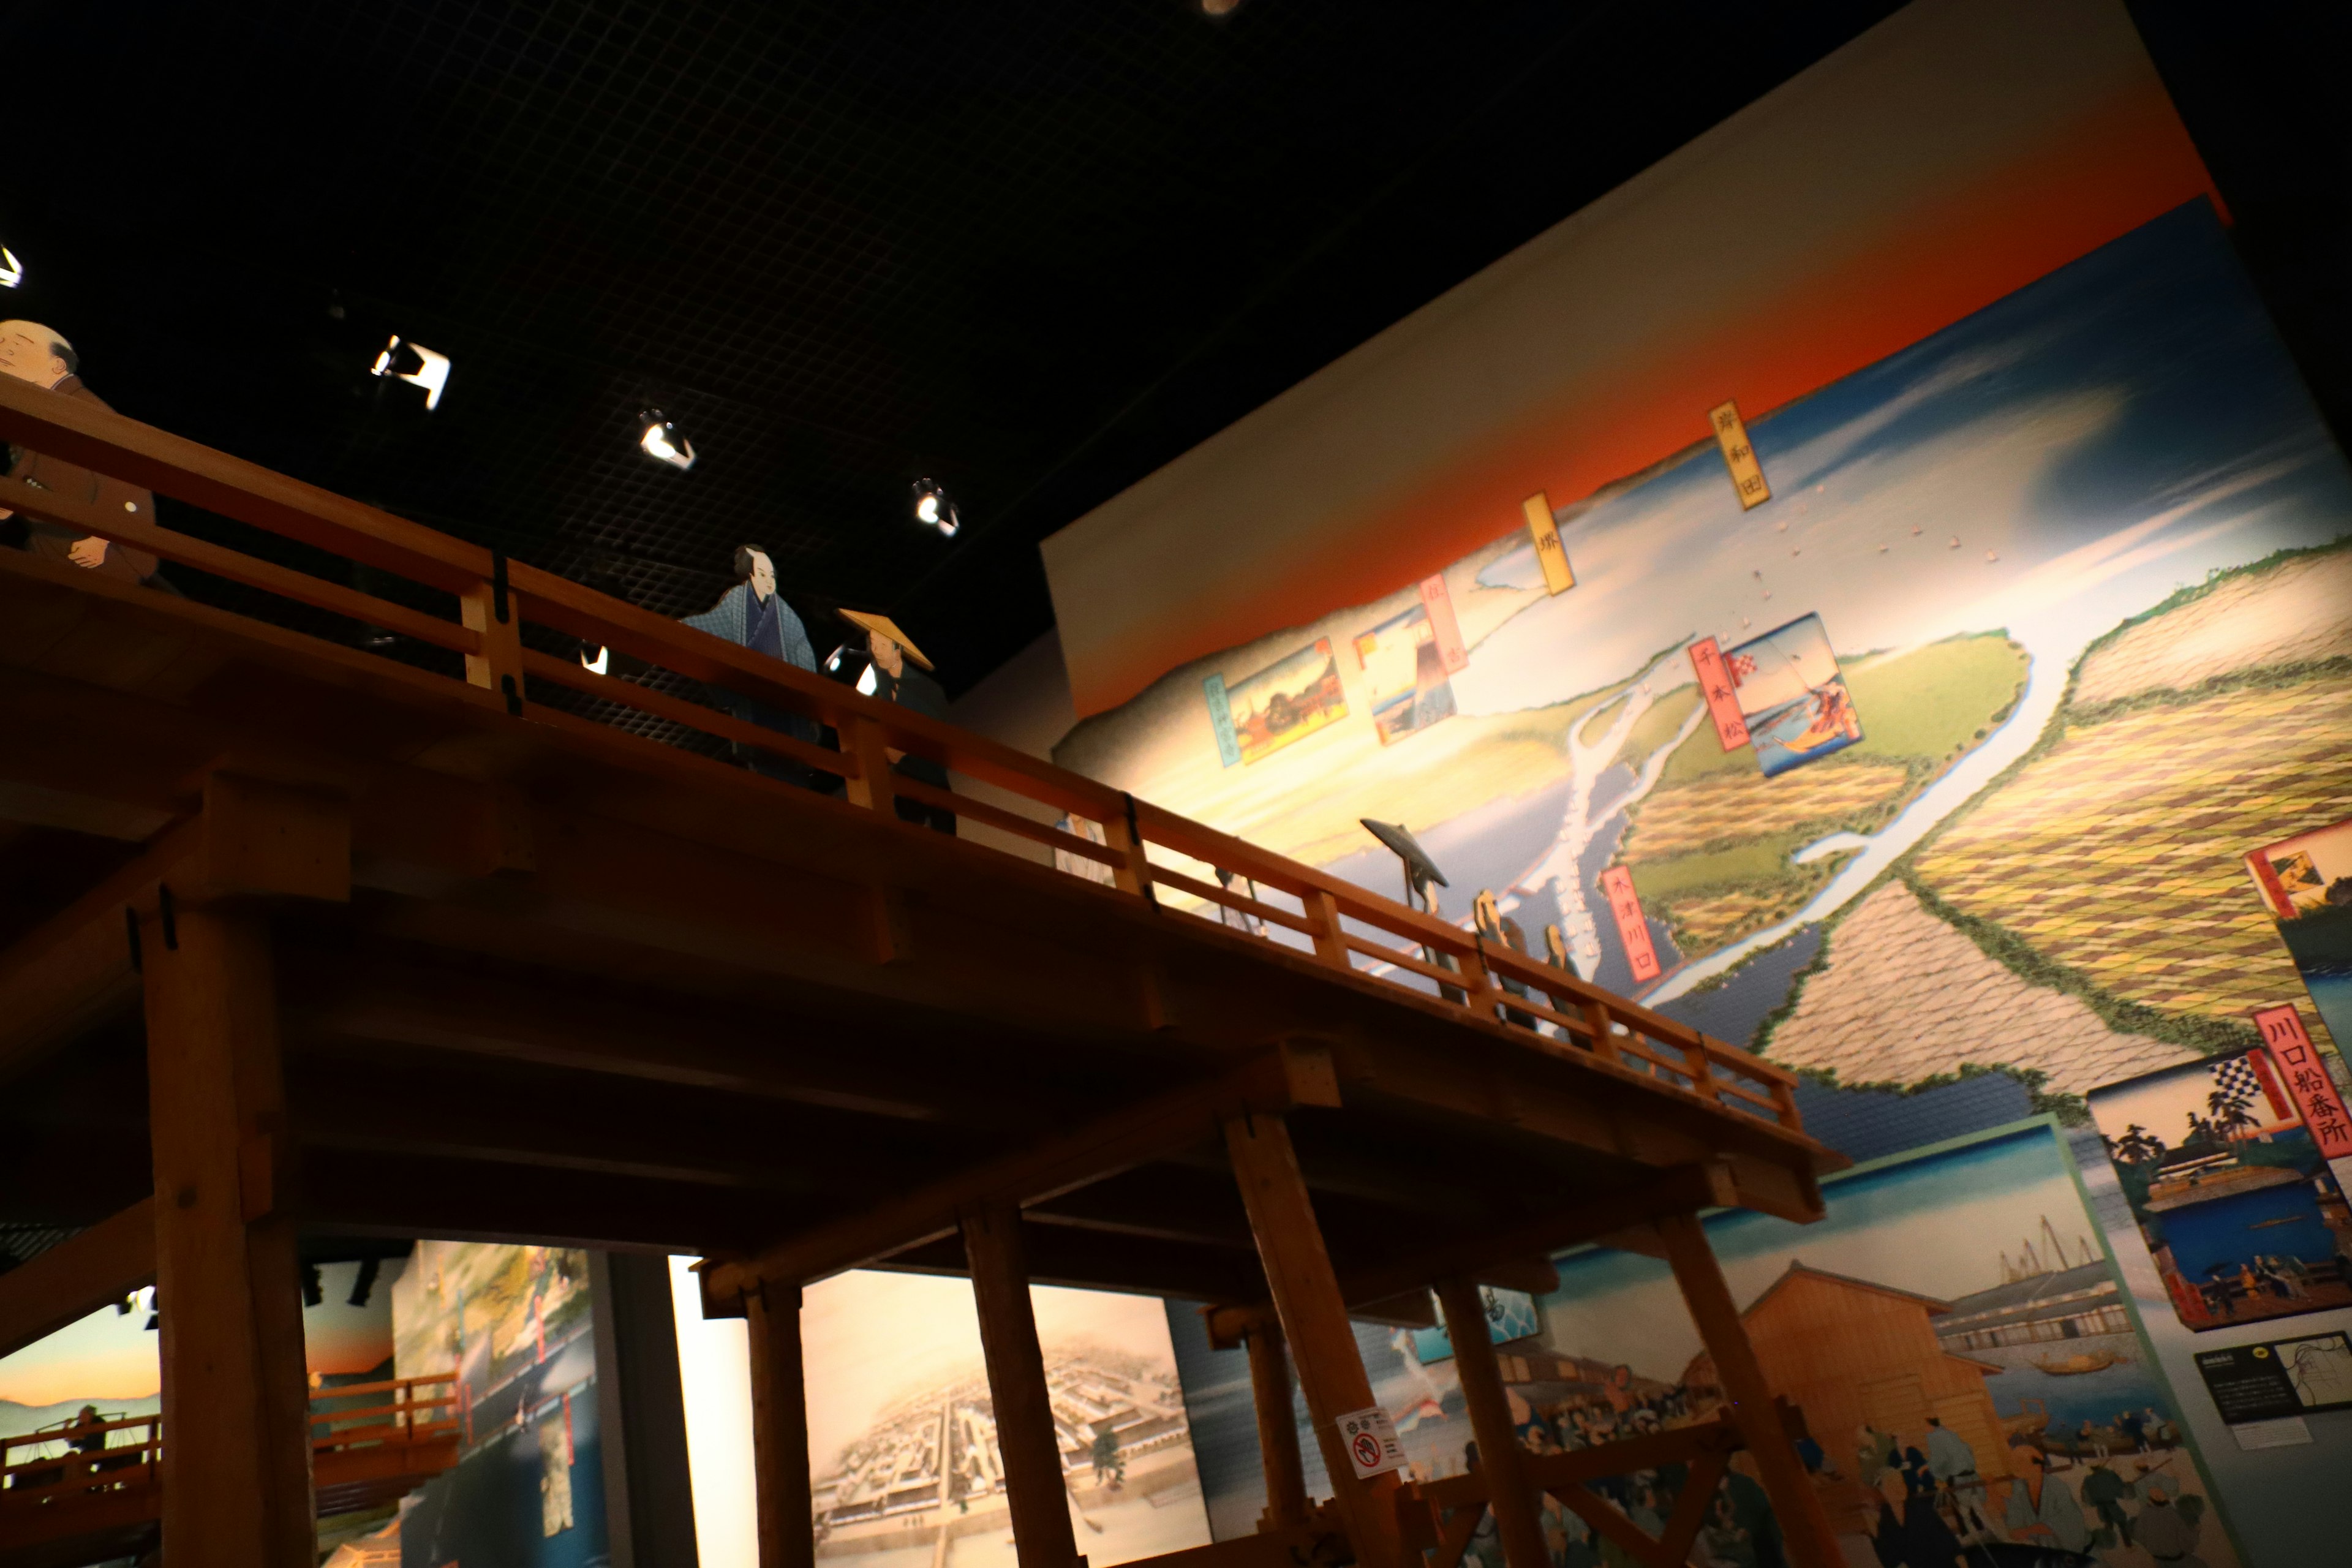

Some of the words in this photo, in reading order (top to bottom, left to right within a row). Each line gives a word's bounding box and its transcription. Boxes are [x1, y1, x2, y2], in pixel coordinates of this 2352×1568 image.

[1698, 647, 1744, 739] 千本松
[2268, 1017, 2348, 1145] 川口船番所
